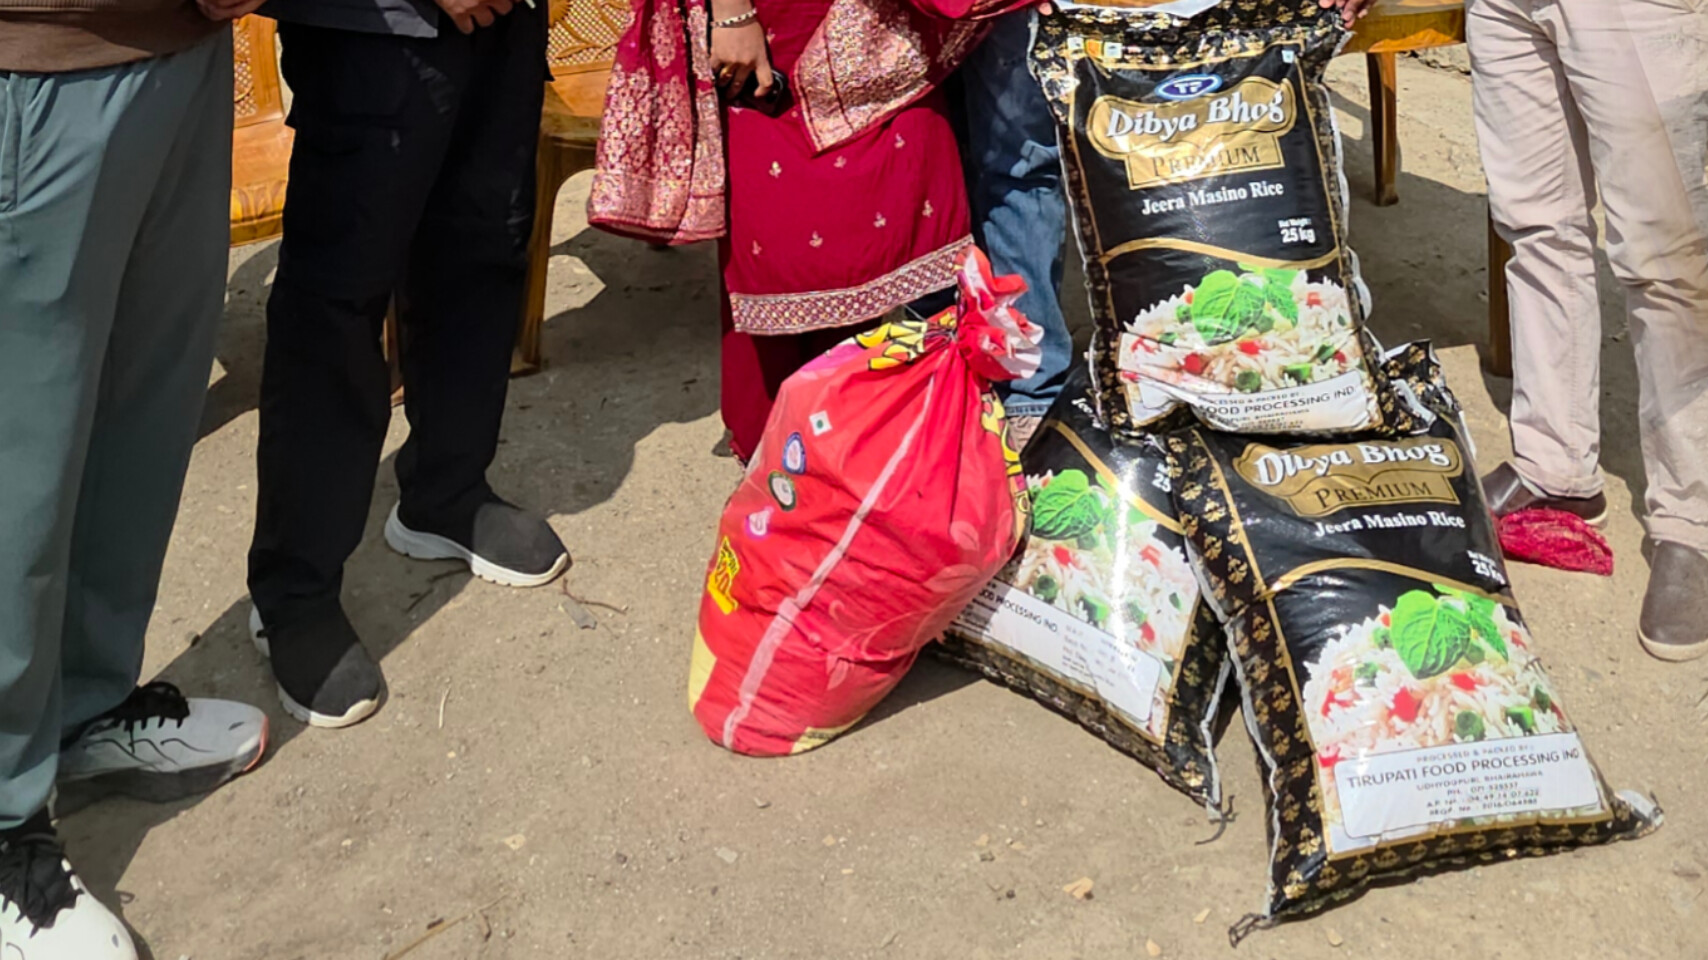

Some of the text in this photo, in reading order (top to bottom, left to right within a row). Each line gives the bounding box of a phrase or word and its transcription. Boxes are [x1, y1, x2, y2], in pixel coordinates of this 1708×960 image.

[1107, 91, 1285, 140] Dibya Bhog
[1151, 143, 1262, 177] PREMIUM
[1141, 181, 1284, 216] Jeera Masino Rice
[1280, 227, 1316, 243] 25 kg
[1244, 393, 1331, 414] PROCESSING
[1314, 481, 1434, 509] PREMIUM
[1314, 511, 1466, 538] Jeera Masino Rice
[1346, 768, 1418, 790] TIRUPATI
[1422, 762, 1467, 779] FOOD
[1471, 749, 1560, 772] PROCESSING
